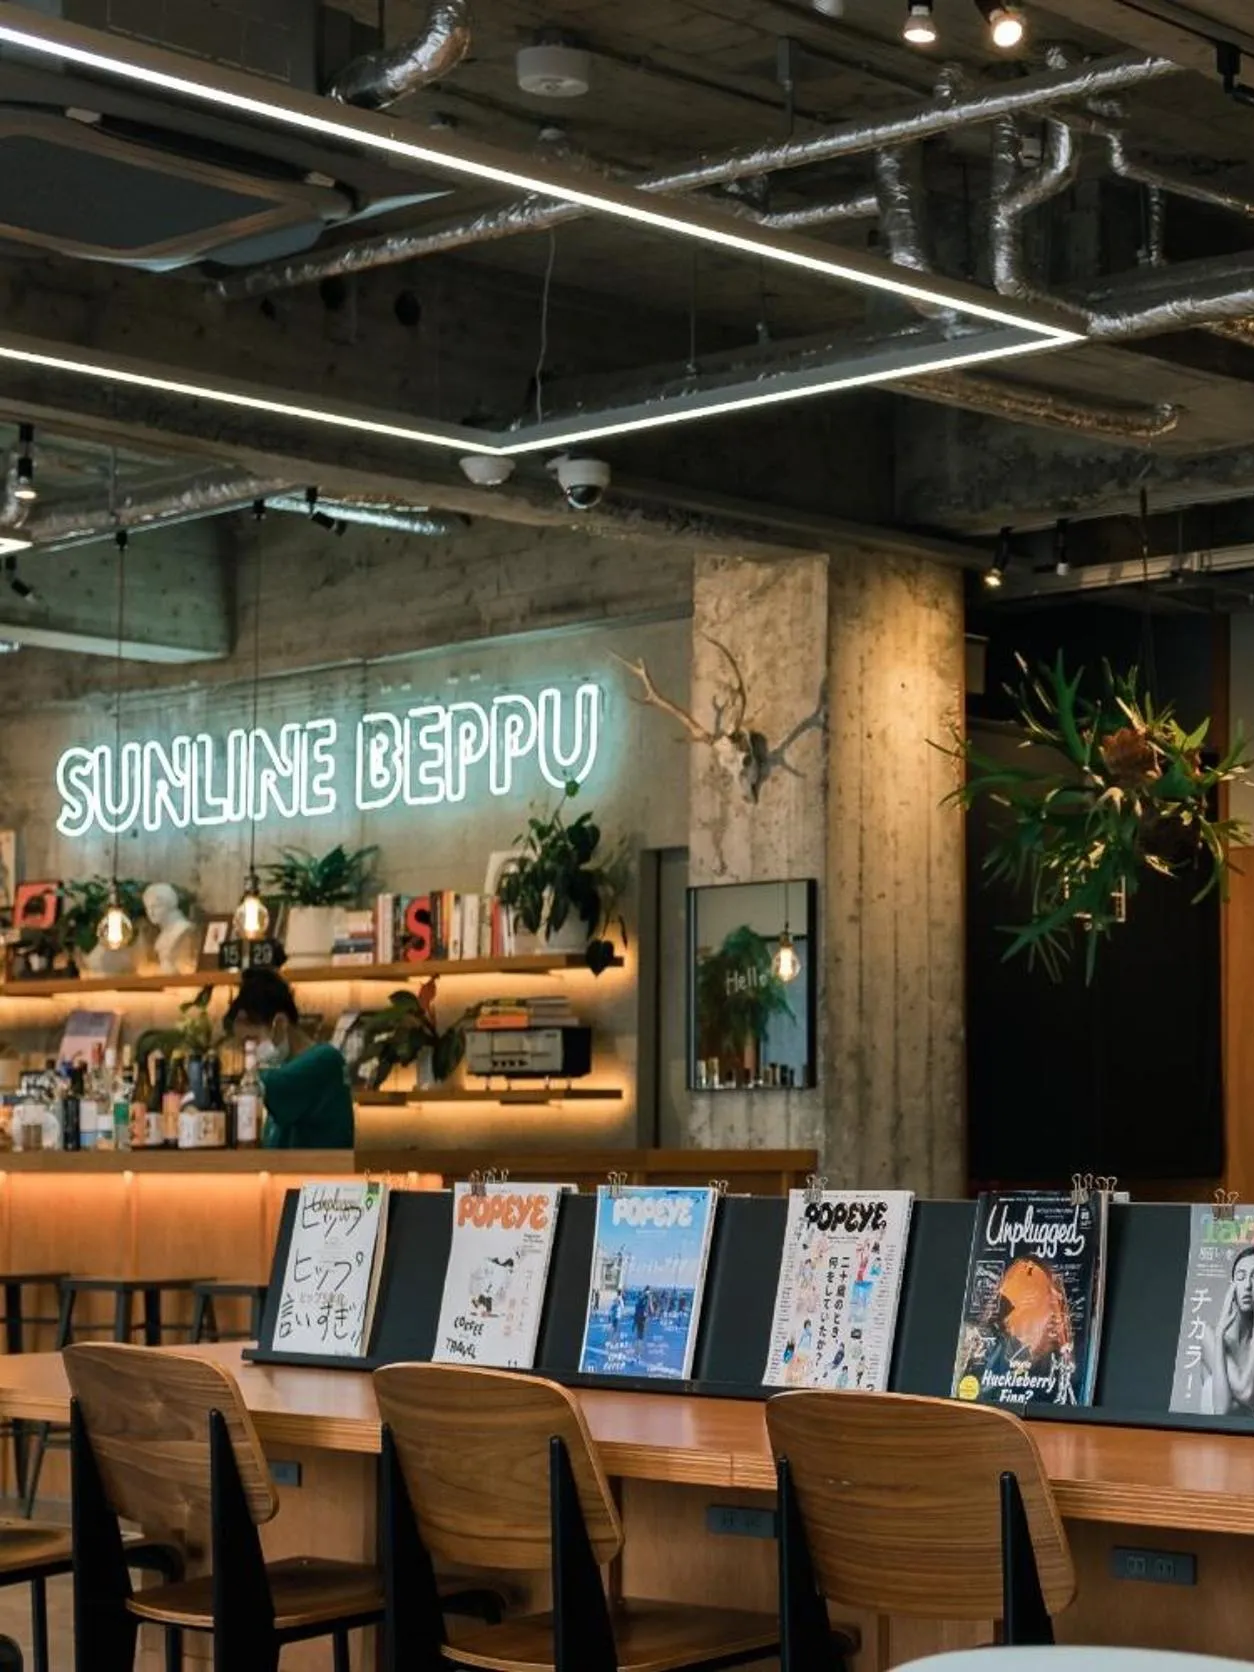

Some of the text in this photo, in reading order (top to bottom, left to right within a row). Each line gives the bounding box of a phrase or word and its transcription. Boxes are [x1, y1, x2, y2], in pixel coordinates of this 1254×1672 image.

[56, 684, 601, 837] SUNLINE BEPPU
[726, 967, 768, 996] Hello
[457, 1194, 550, 1232] POPEYE
[612, 1196, 693, 1227] POPEYE
[805, 1201, 888, 1233] POPEYE
[985, 1204, 1085, 1258] Unplugged
[294, 1249, 365, 1292] ヒップ
[454, 1316, 485, 1336] COFFEE
[981, 1369, 1056, 1393] Huckleberry
[999, 1388, 1034, 1404] Finn?
